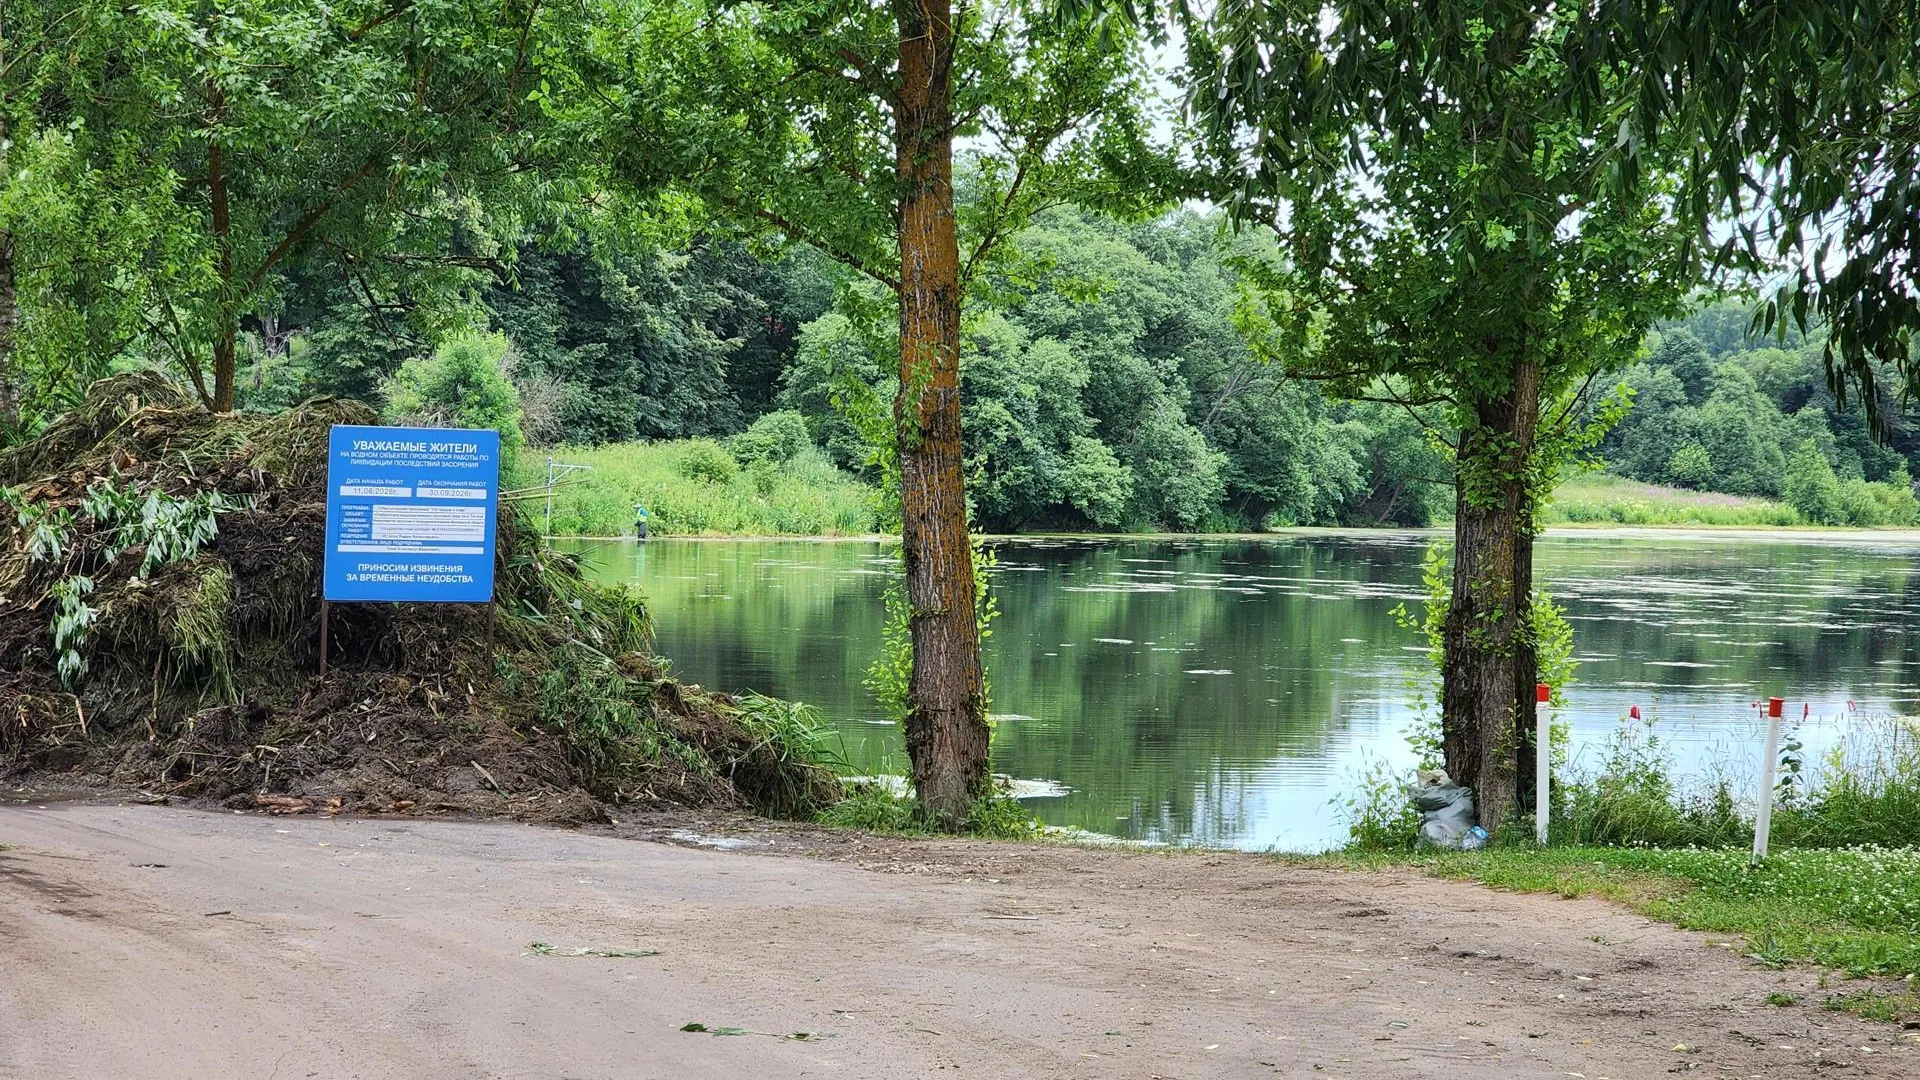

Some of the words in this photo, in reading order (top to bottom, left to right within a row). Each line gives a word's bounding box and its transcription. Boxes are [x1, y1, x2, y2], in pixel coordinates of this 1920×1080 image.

[352, 440, 426, 452] УВАЖАЕМЫЕ
[430, 442, 478, 454] ЖИТЕЛИ
[394, 460, 440, 468] ПОСЛЕДСТВИЙ
[442, 461, 479, 469] ЗАСОРЕНИЯ
[358, 563, 408, 572] ПРИНОСИМ
[410, 564, 463, 573] ИЗВИНЕНИЯ
[346, 573, 358, 581] ЗА
[360, 573, 415, 582] ВРЕМЕННЫЕ
[417, 574, 473, 584] НЕУДОБСТВА
